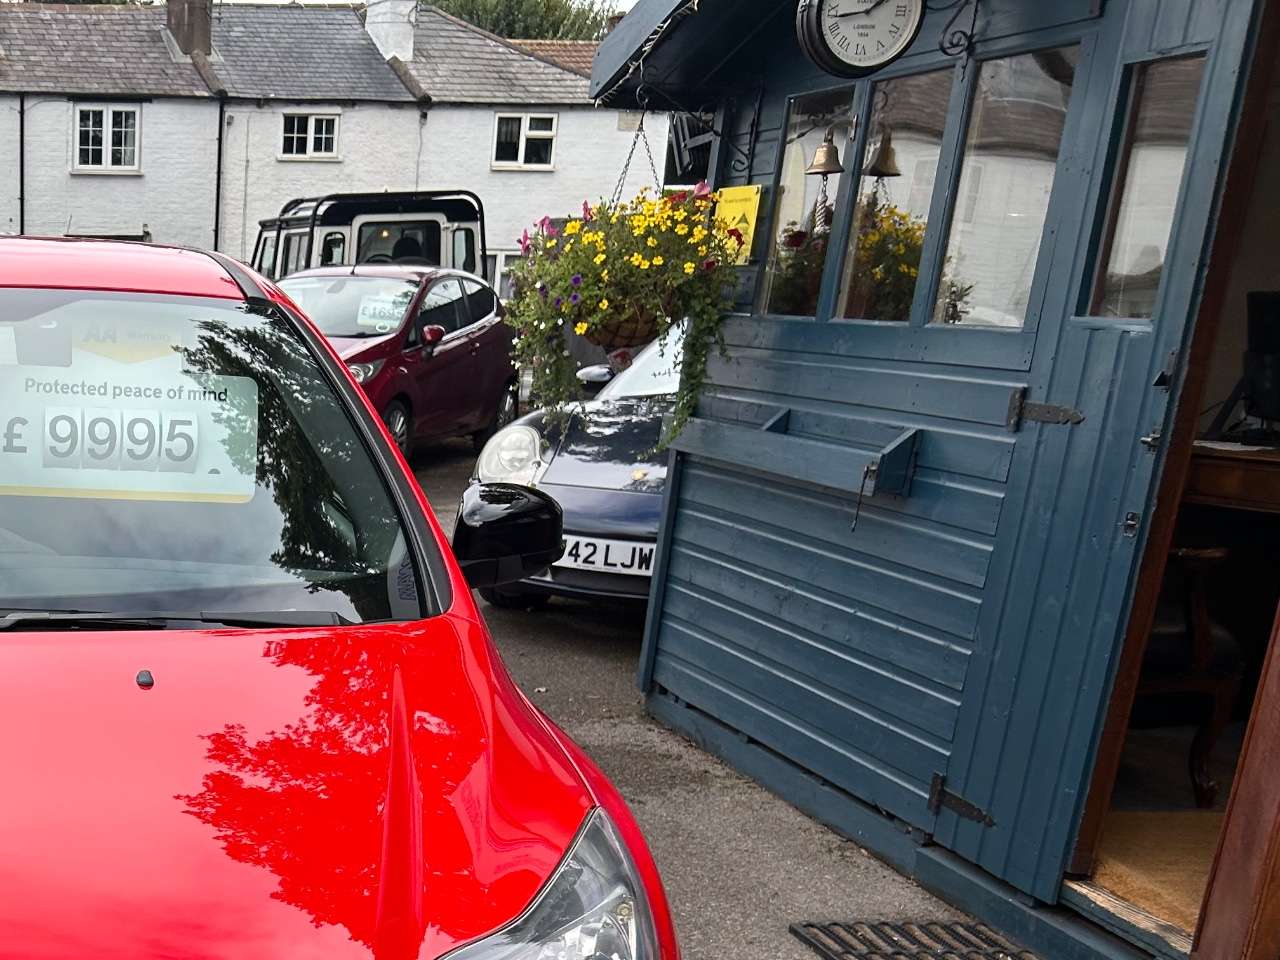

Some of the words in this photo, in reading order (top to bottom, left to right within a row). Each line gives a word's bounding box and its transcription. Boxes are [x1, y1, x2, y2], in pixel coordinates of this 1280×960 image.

[895, 5, 907, 16] III
[24, 378, 108, 397] Protected
[112, 383, 162, 401] peace
[166, 386, 184, 399] of
[187, 388, 228, 402] mind
[48, 414, 195, 463] 9995
[562, 539, 598, 565] 42
[604, 544, 654, 571] LJW
